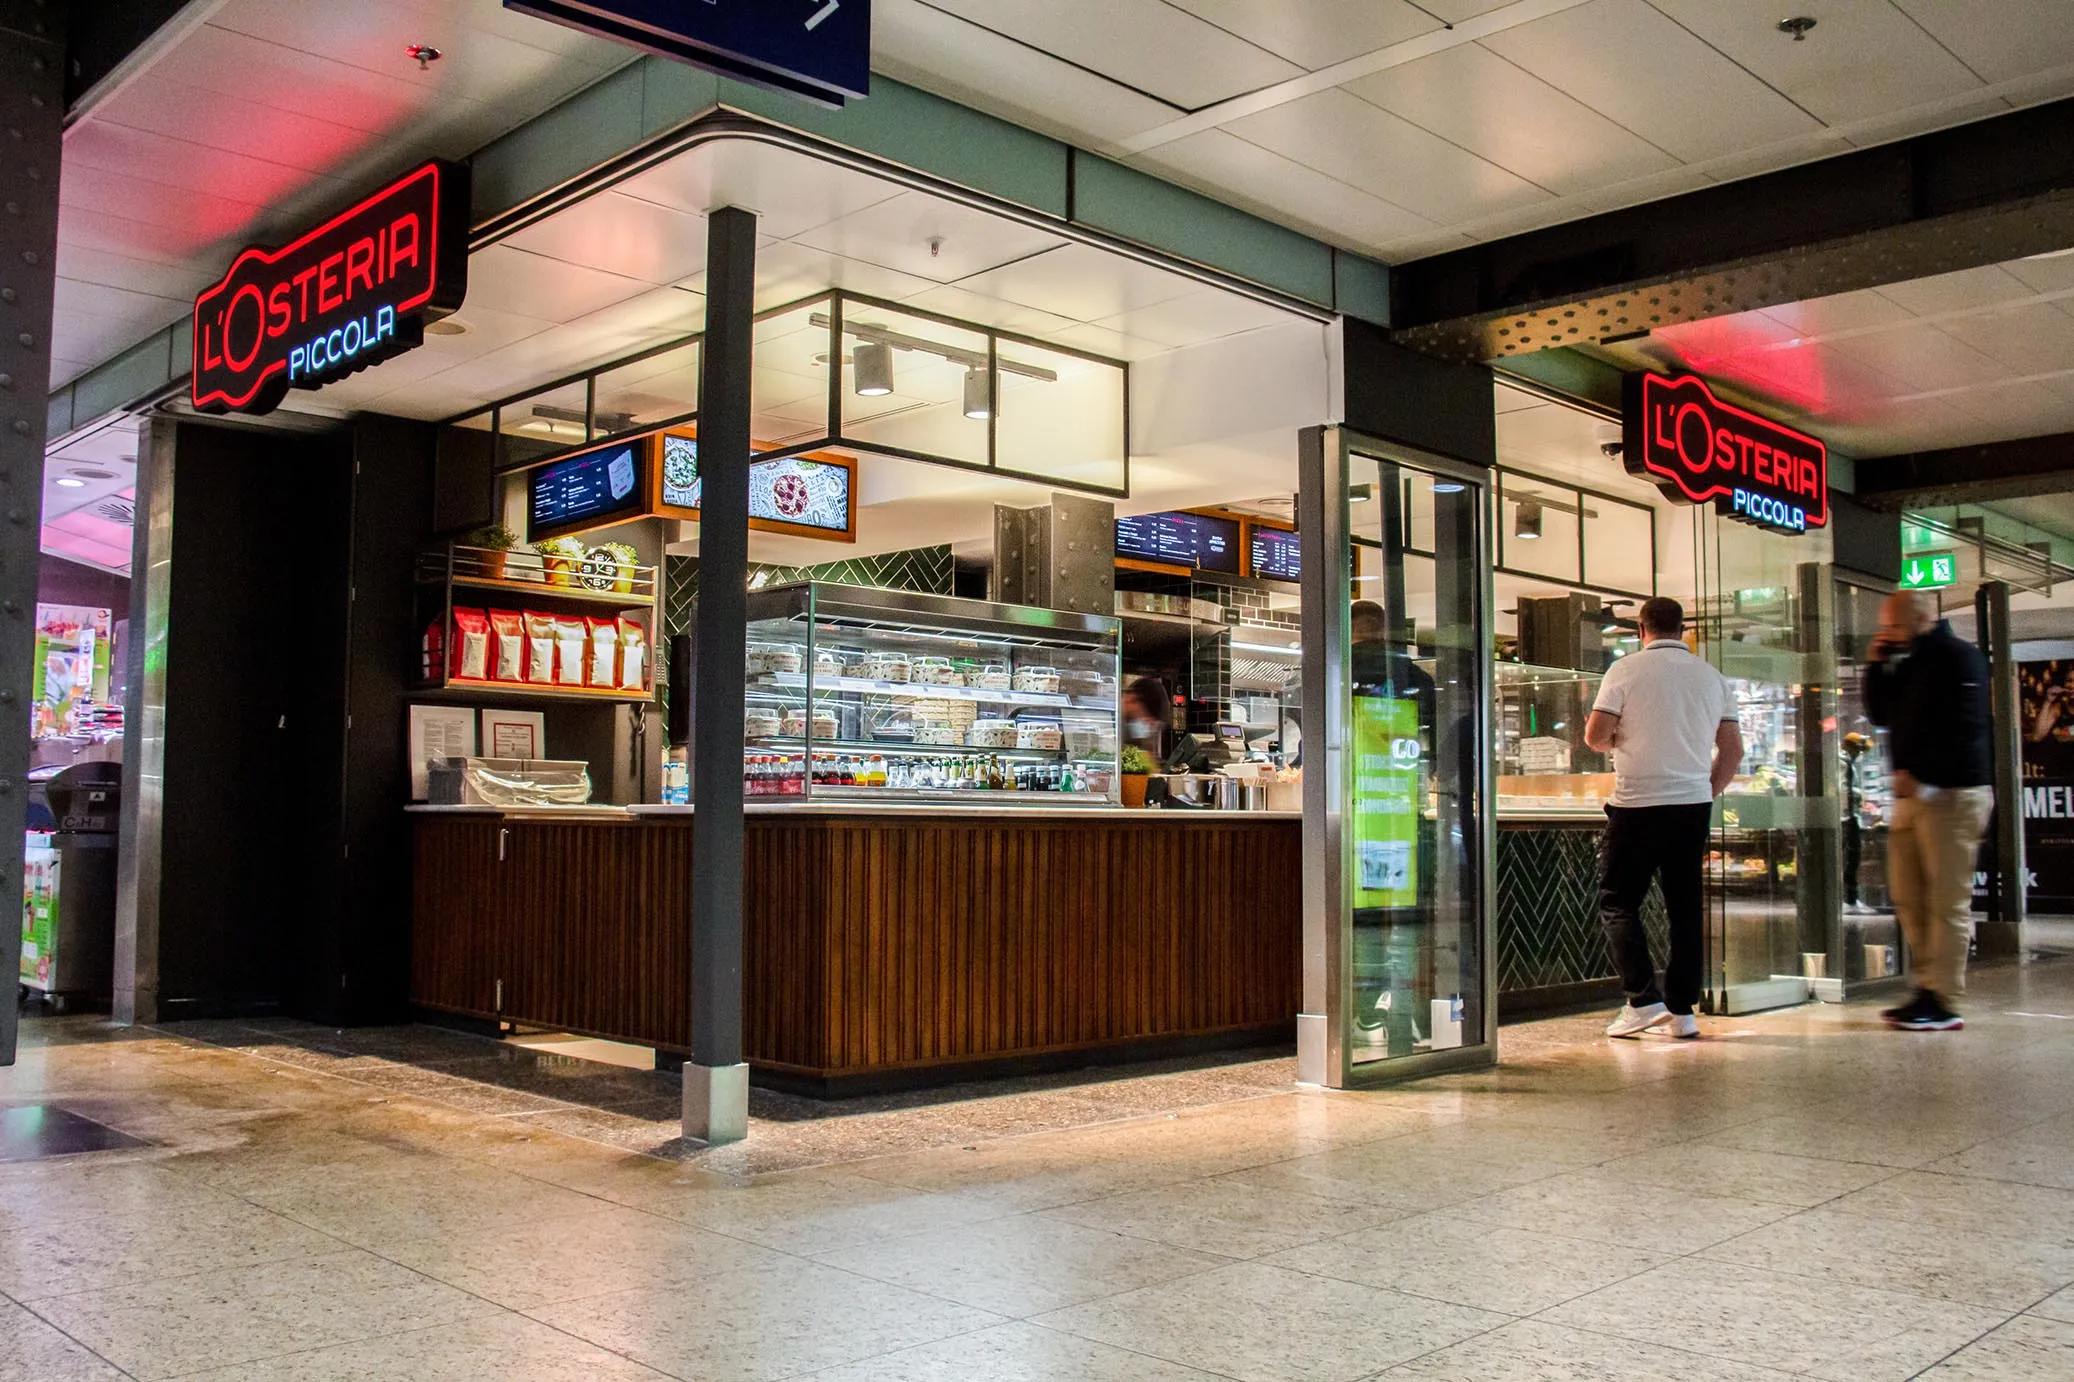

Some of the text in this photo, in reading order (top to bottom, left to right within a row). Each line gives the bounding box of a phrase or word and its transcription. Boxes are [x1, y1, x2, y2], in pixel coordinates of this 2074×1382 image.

[204, 212, 419, 373] L'OSTERIA
[289, 304, 395, 381] PICCOLA
[1655, 402, 1818, 499] L'OSTERIA
[1732, 487, 1806, 531] PICCOLA
